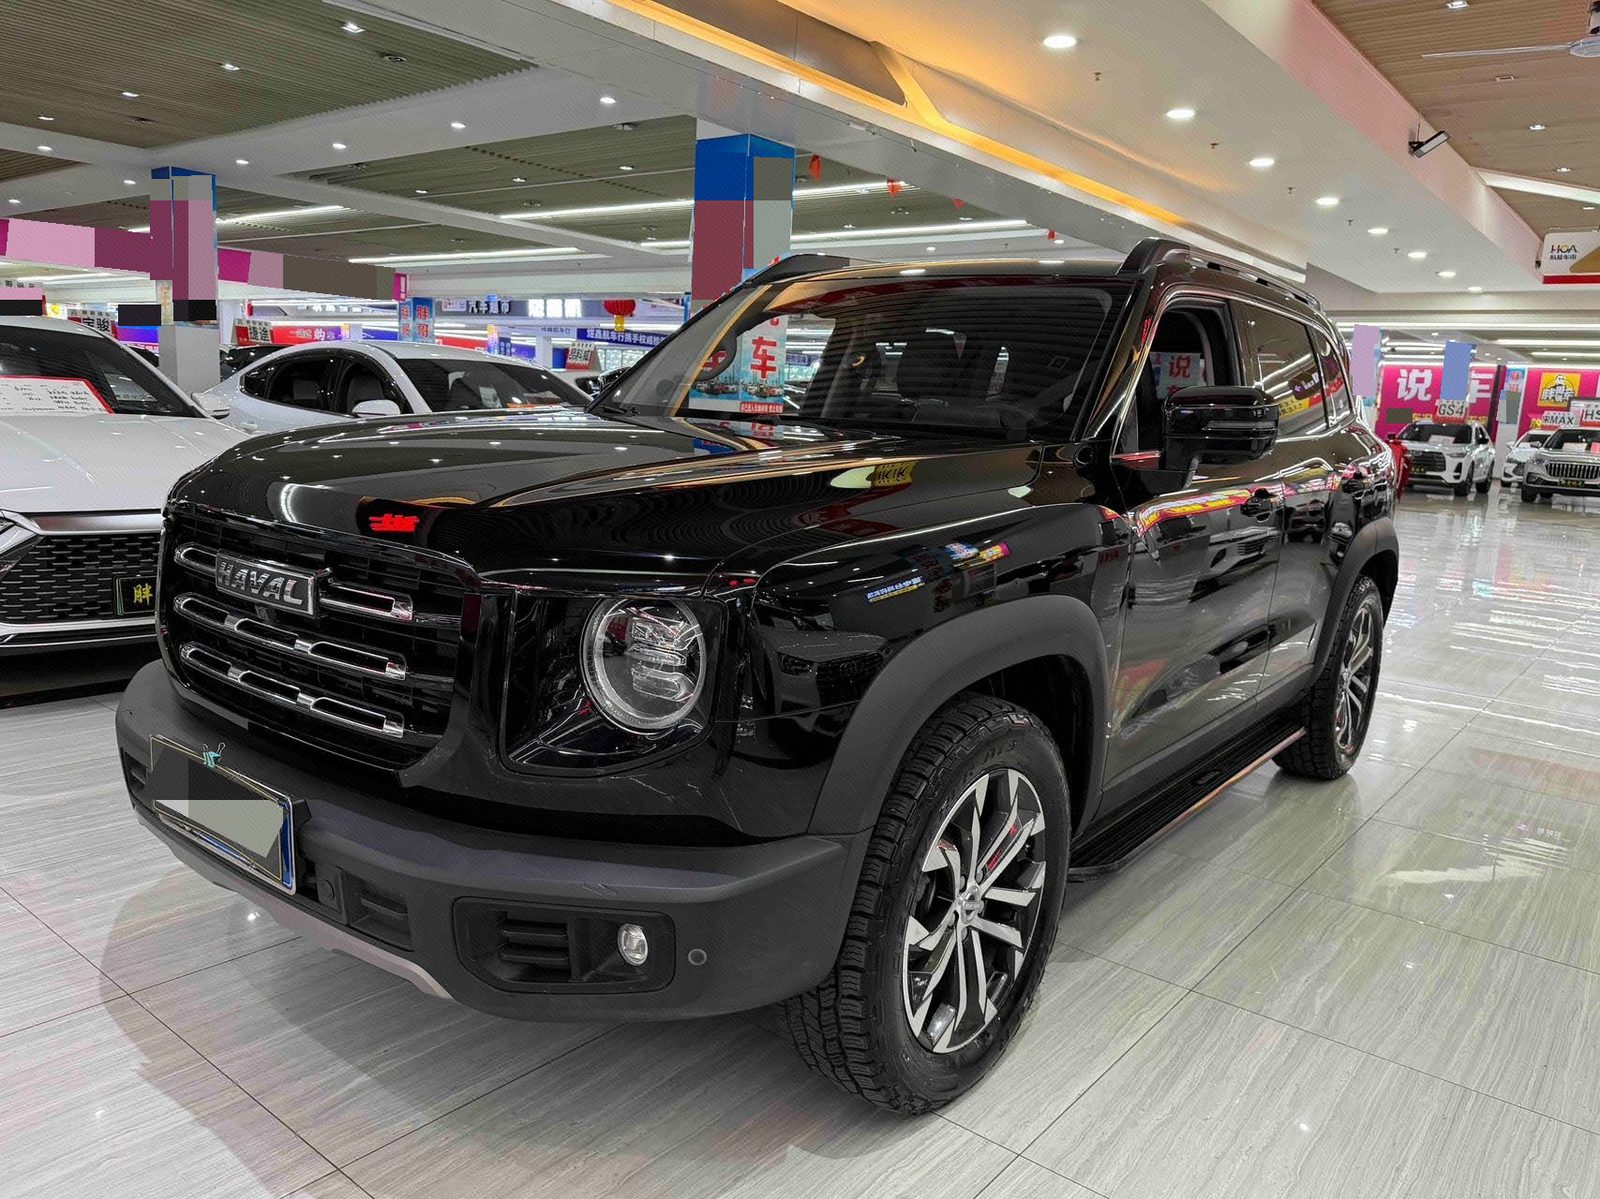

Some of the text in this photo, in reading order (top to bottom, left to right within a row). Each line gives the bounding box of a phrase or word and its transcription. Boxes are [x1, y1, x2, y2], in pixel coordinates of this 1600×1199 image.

[469, 300, 510, 314] 汽车超市
[750, 336, 778, 379] 车
[1438, 403, 1465, 417] GS4
[219, 560, 303, 605] HAVAL
